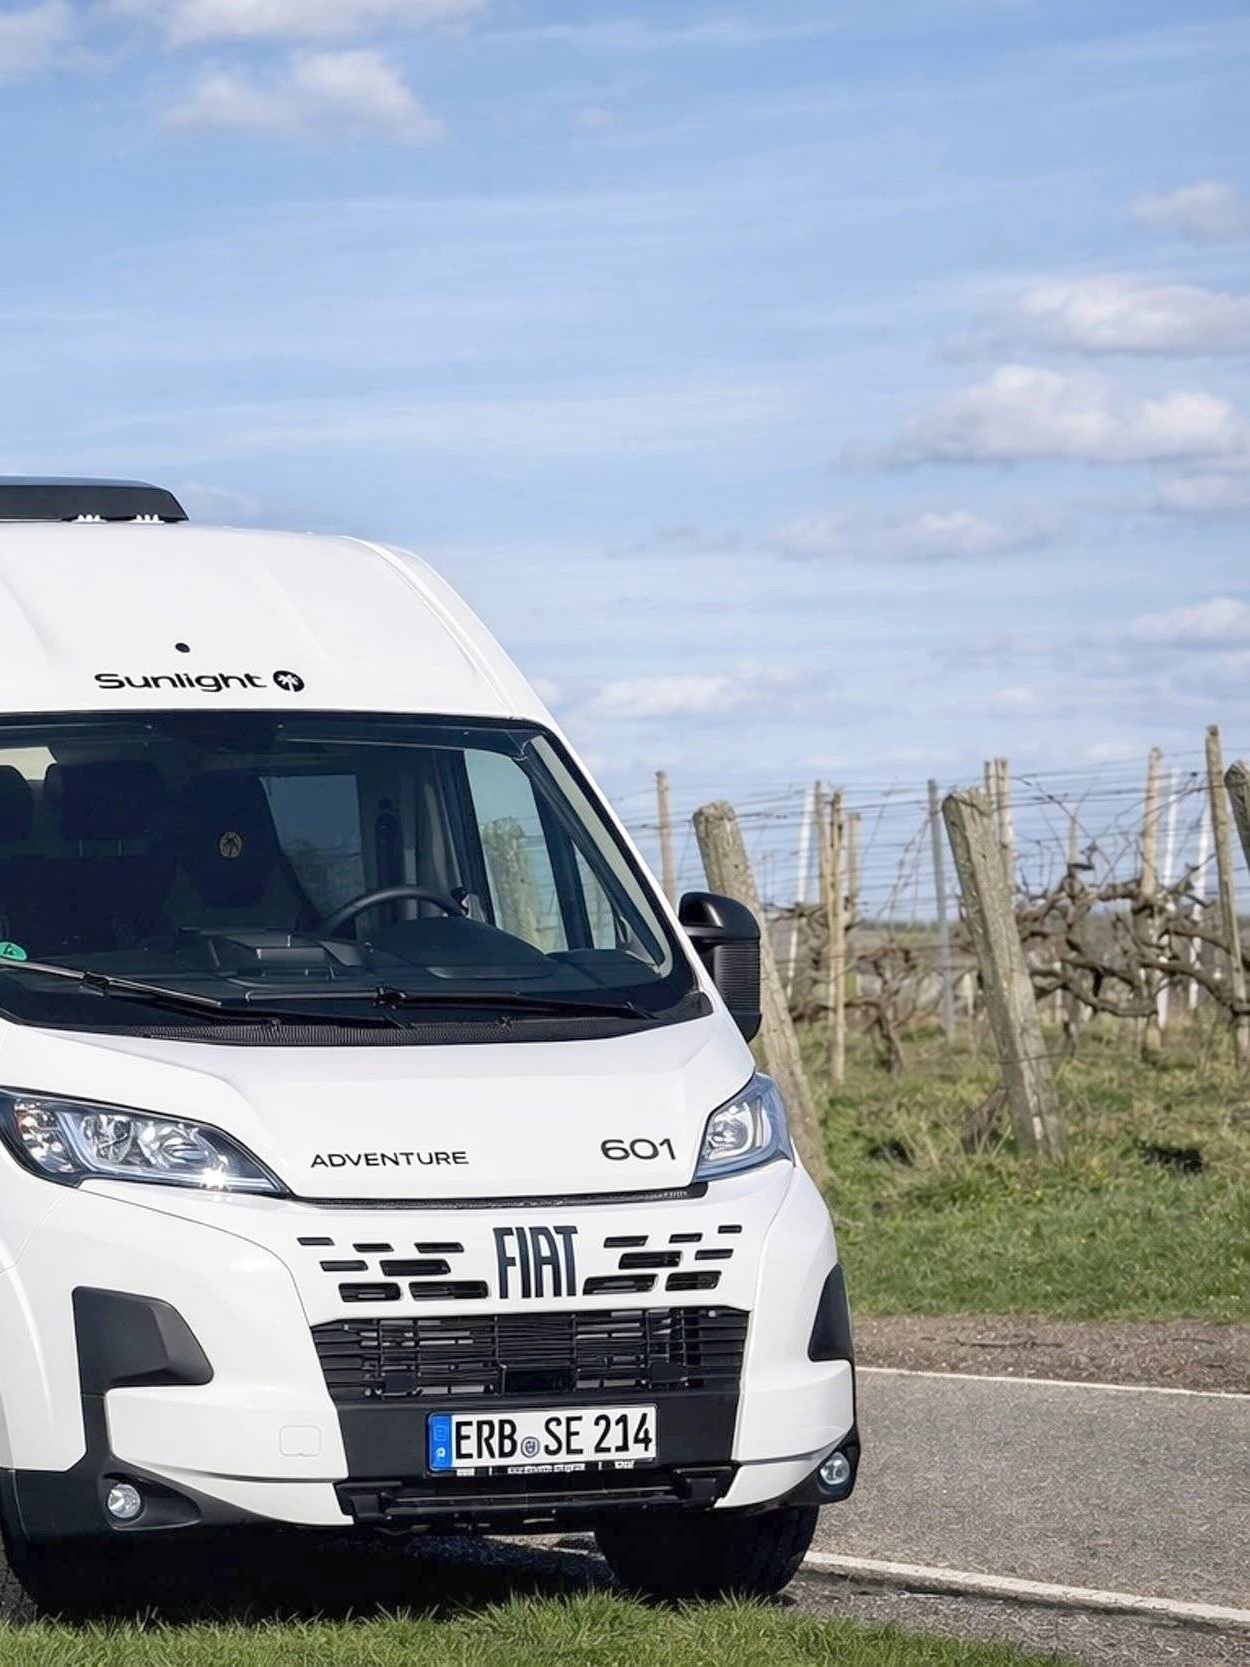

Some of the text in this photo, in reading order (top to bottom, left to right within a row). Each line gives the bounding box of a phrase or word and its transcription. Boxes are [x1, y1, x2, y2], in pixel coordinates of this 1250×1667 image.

[94, 672, 268, 693] Sunlight
[310, 1151, 469, 1168] ADVENTURE
[600, 1138, 676, 1161] 601
[492, 1225, 579, 1300] FIAT
[455, 1412, 653, 1460] ERB SE 214
